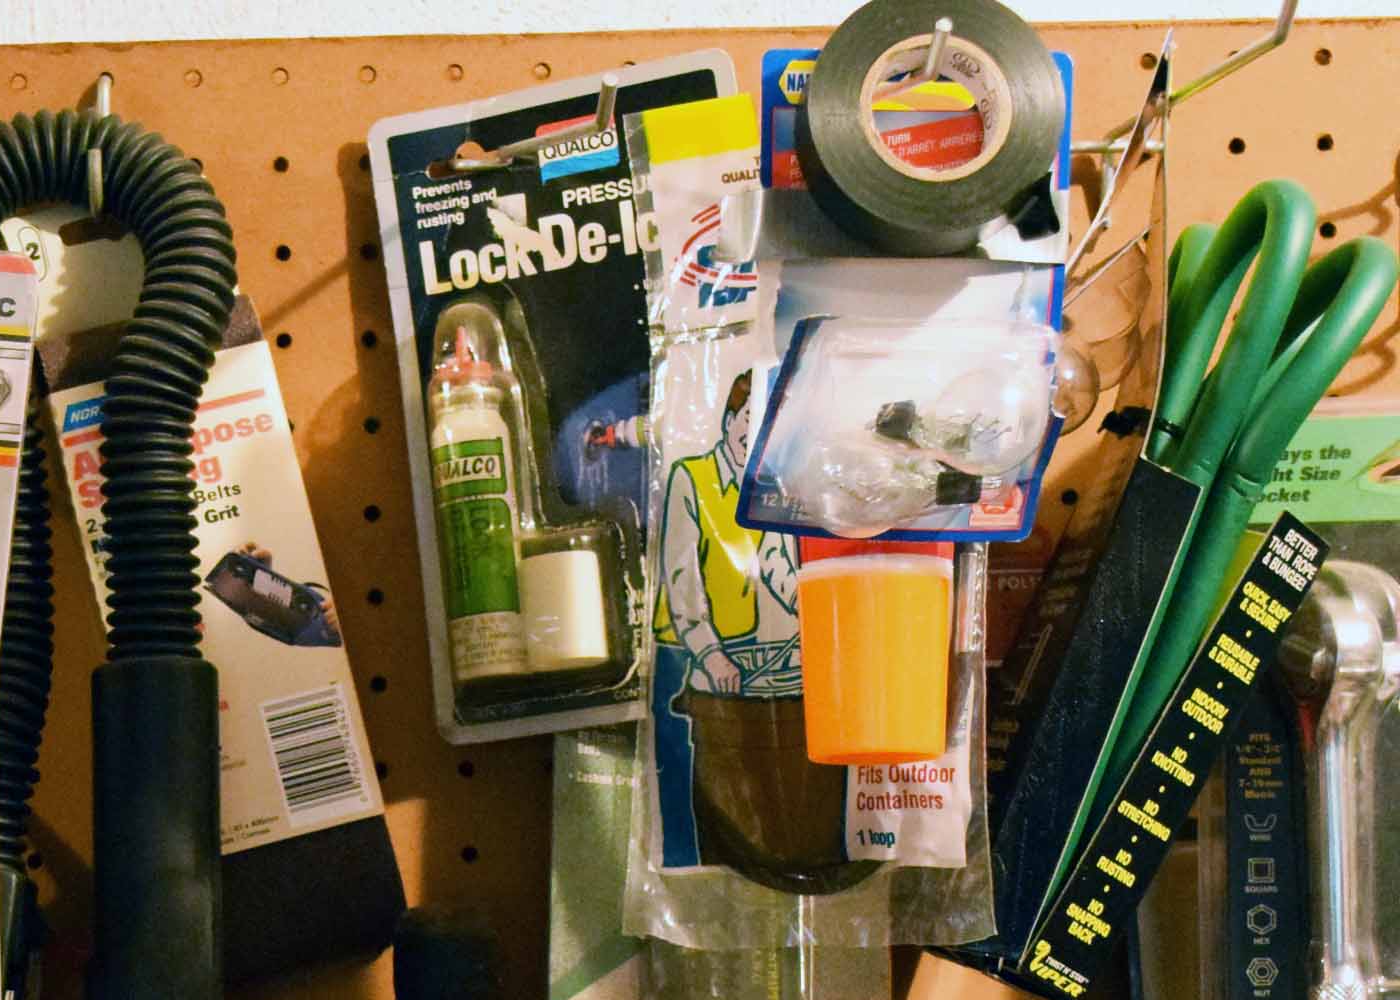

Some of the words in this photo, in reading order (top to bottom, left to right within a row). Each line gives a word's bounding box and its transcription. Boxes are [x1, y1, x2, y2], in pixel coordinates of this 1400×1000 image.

[787, 73, 810, 91] NA
[542, 131, 614, 160] QUALCO
[412, 179, 472, 199] Prevents
[562, 175, 652, 208] PRESSU
[416, 194, 469, 214] freezing
[472, 188, 497, 203] and
[417, 212, 465, 229] rusting
[419, 234, 538, 296] Lock
[539, 201, 662, 272] De-Ic
[70, 407, 100, 423] NOR
[191, 413, 273, 454] pose
[1280, 448, 1313, 464] ays
[1319, 445, 1352, 460] the
[1300, 466, 1341, 481] Size
[193, 483, 242, 504] Belts
[204, 505, 240, 524] Grit
[1284, 528, 1320, 561] BETTER
[1268, 535, 1292, 562] THAN
[1292, 554, 1318, 581] ROPE
[1248, 601, 1280, 633] SECURE
[1268, 600, 1293, 623] EASY
[1216, 633, 1260, 671] REUSABLE
[1216, 651, 1255, 685] DURABLE
[1181, 700, 1224, 735] OUTDOOR
[1171, 746, 1188, 764] NO
[857, 765, 883, 784] Fits
[888, 764, 956, 783] Outdoor
[856, 789, 943, 811] Containers
[1143, 799, 1160, 817] NO
[1117, 800, 1171, 842] STRETCHING
[868, 829, 895, 848] loop
[1115, 848, 1133, 866] NO
[1096, 855, 1137, 888] RUSTING
[1087, 898, 1105, 916] NO
[1066, 902, 1112, 938] SNAPPING
[1067, 921, 1096, 945] BACK
[1030, 950, 1086, 998] VIPER
